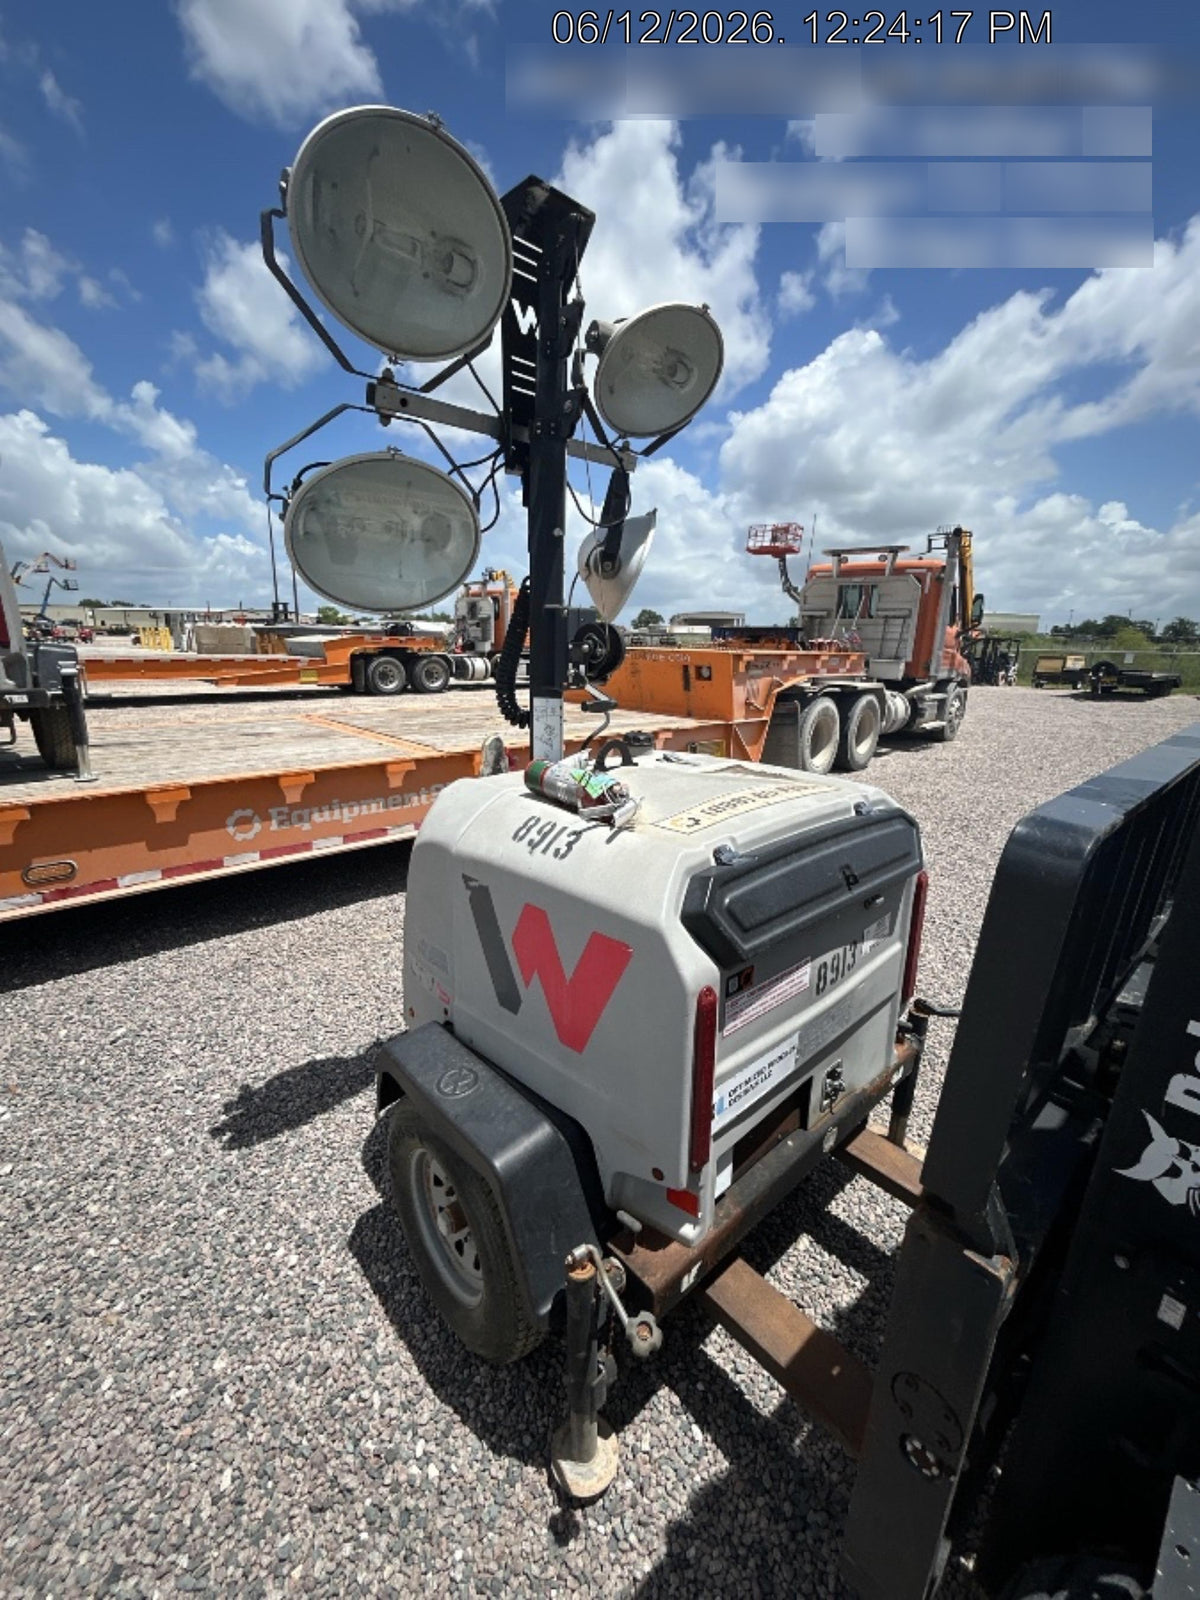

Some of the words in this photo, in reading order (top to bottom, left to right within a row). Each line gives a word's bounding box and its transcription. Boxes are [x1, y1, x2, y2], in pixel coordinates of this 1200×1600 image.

[268, 783, 450, 831] EquipmentS
[511, 815, 583, 861] 8913
[815, 939, 859, 996] 8913
